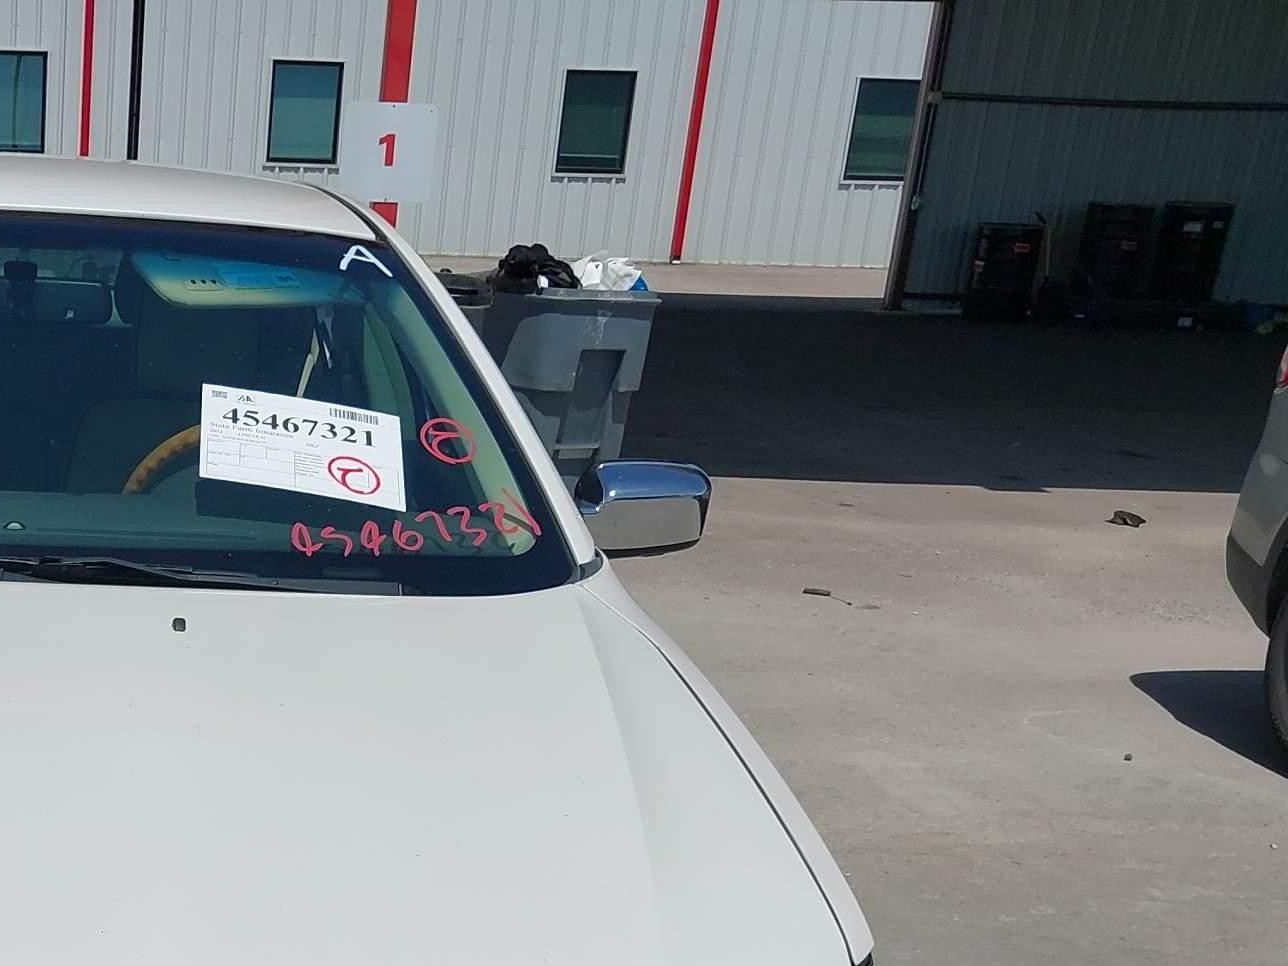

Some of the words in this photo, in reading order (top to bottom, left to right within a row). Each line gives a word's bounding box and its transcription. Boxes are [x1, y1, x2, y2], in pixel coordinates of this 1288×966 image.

[378, 133, 396, 166] 1
[339, 245, 393, 278] A
[222, 407, 376, 448] 45467321
[290, 487, 542, 557] 45467321
